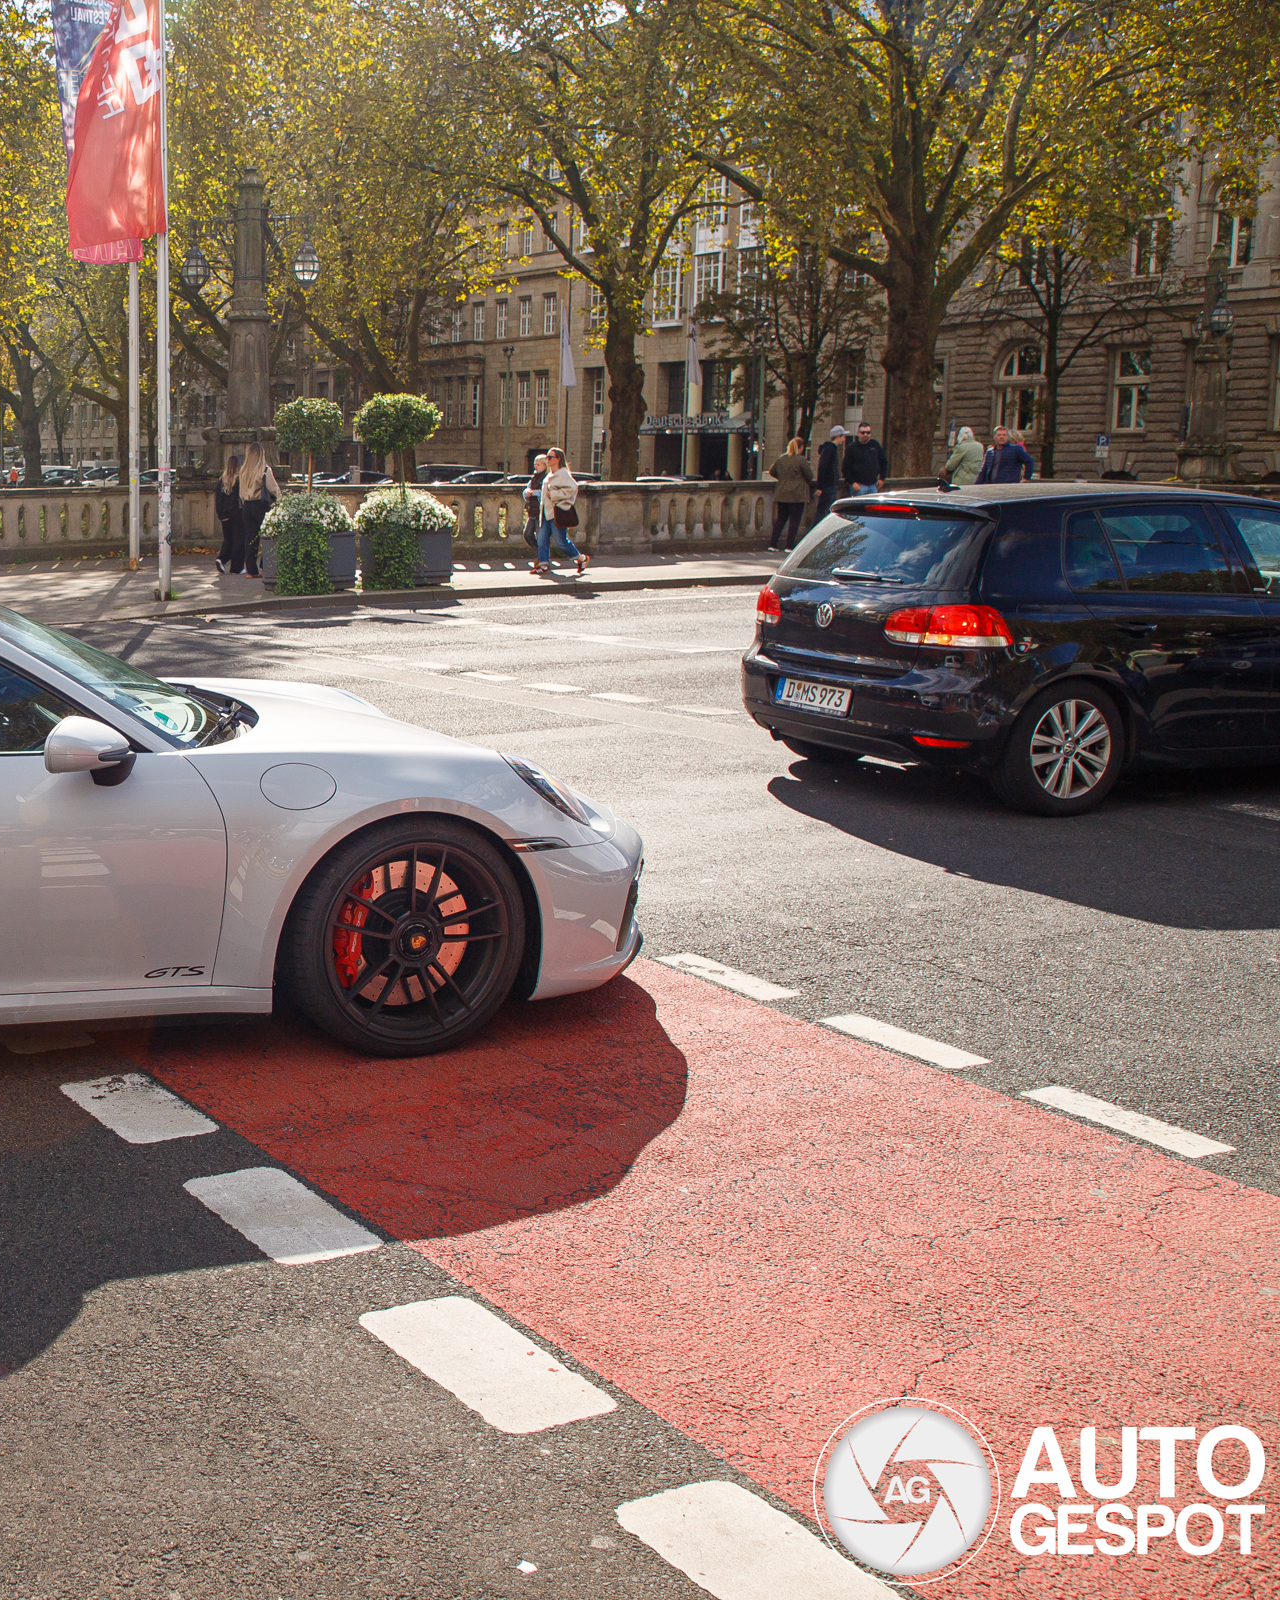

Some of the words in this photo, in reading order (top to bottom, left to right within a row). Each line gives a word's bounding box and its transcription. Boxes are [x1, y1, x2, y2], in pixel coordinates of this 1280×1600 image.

[695, 412, 724, 425] Bank
[786, 681, 796, 698] D
[800, 683, 818, 703] MS
[819, 687, 846, 708] 973
[144, 965, 206, 978] GTS
